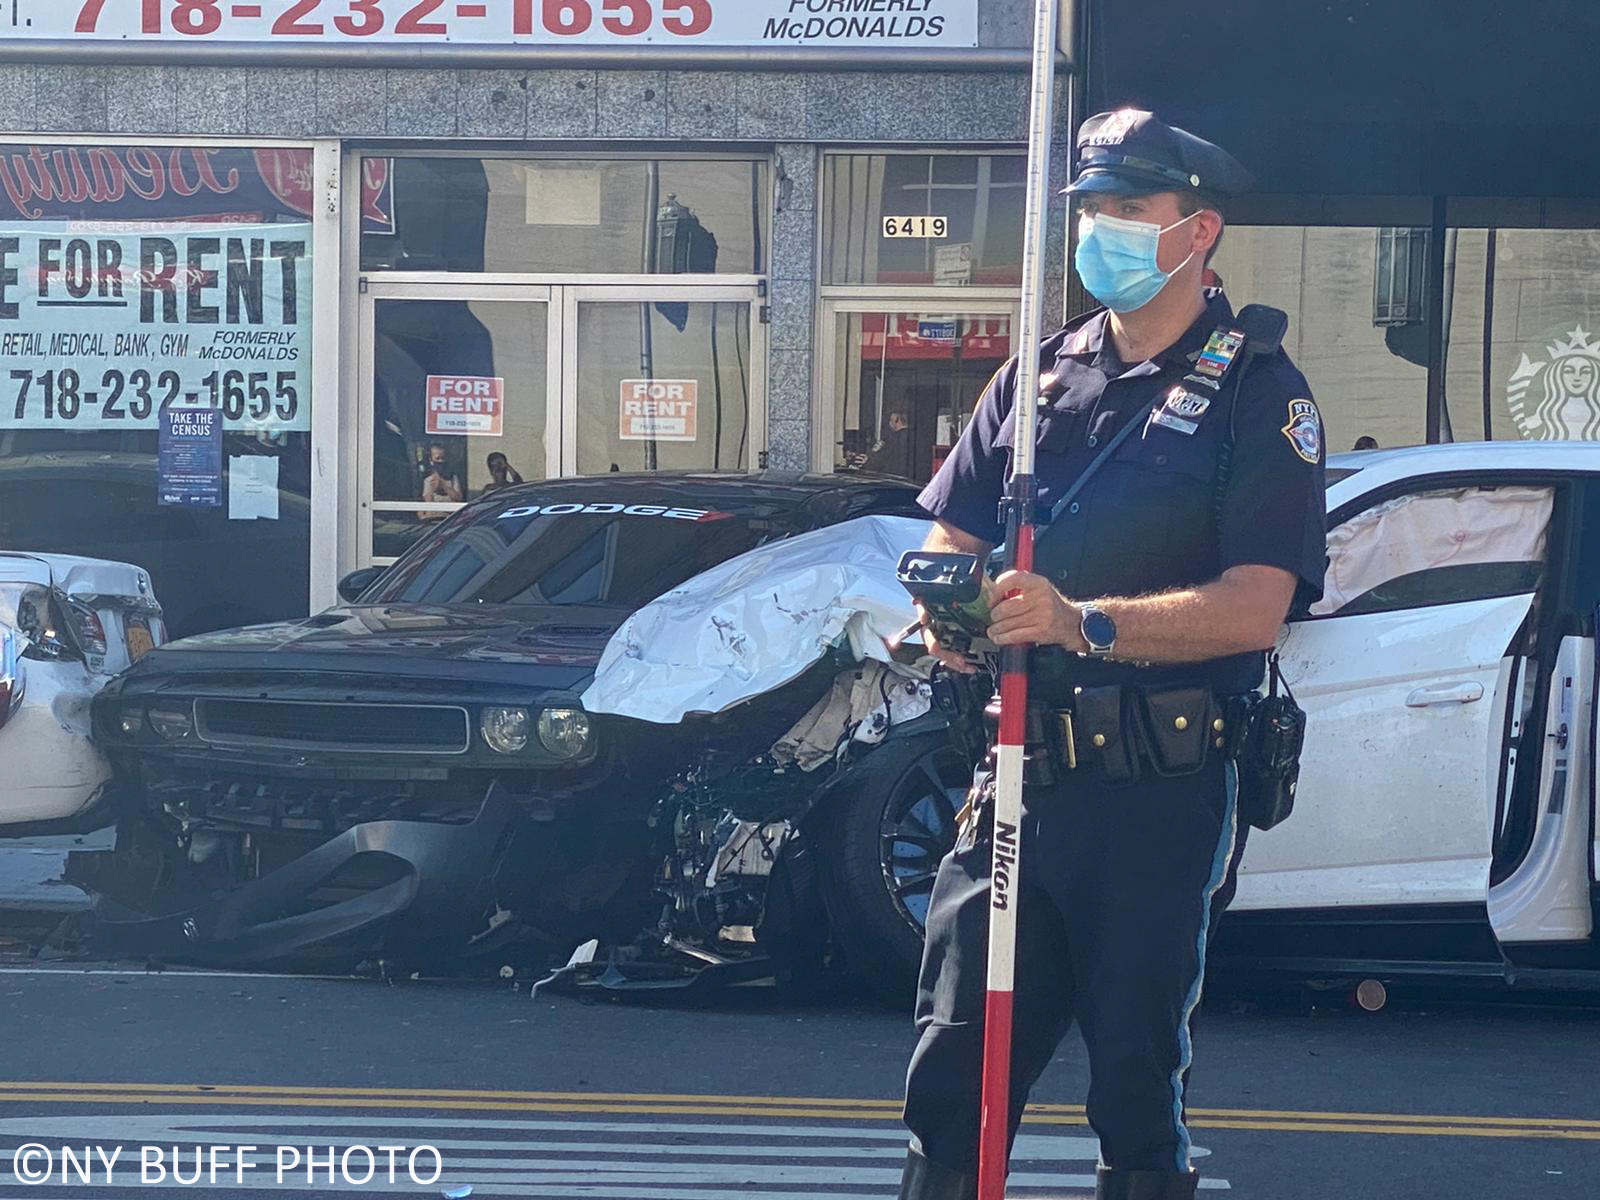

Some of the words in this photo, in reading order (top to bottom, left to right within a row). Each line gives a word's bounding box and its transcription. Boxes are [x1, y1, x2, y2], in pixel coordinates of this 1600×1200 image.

[763, 16, 945, 38] McDONALDS
[885, 218, 945, 236] 6419
[38, 238, 123, 298] FOR
[139, 237, 305, 325] RENT
[213, 331, 296, 344] FORMERLY
[2, 333, 48, 359] RETAIL,
[49, 333, 108, 360] MEDICAL,
[160, 334, 189, 358] GYM
[198, 346, 299, 361] McDONALDS
[10, 368, 299, 421] 718-232-1655
[439, 379, 490, 396] FOR
[632, 384, 684, 400] FOR
[430, 397, 499, 413] RENT
[624, 401, 692, 417] RENT
[169, 412, 192, 425] TAKE
[195, 413, 214, 425] THE
[171, 424, 211, 436] CENSUS
[498, 503, 709, 521] DODGE
[992, 820, 1017, 911] Nikon
